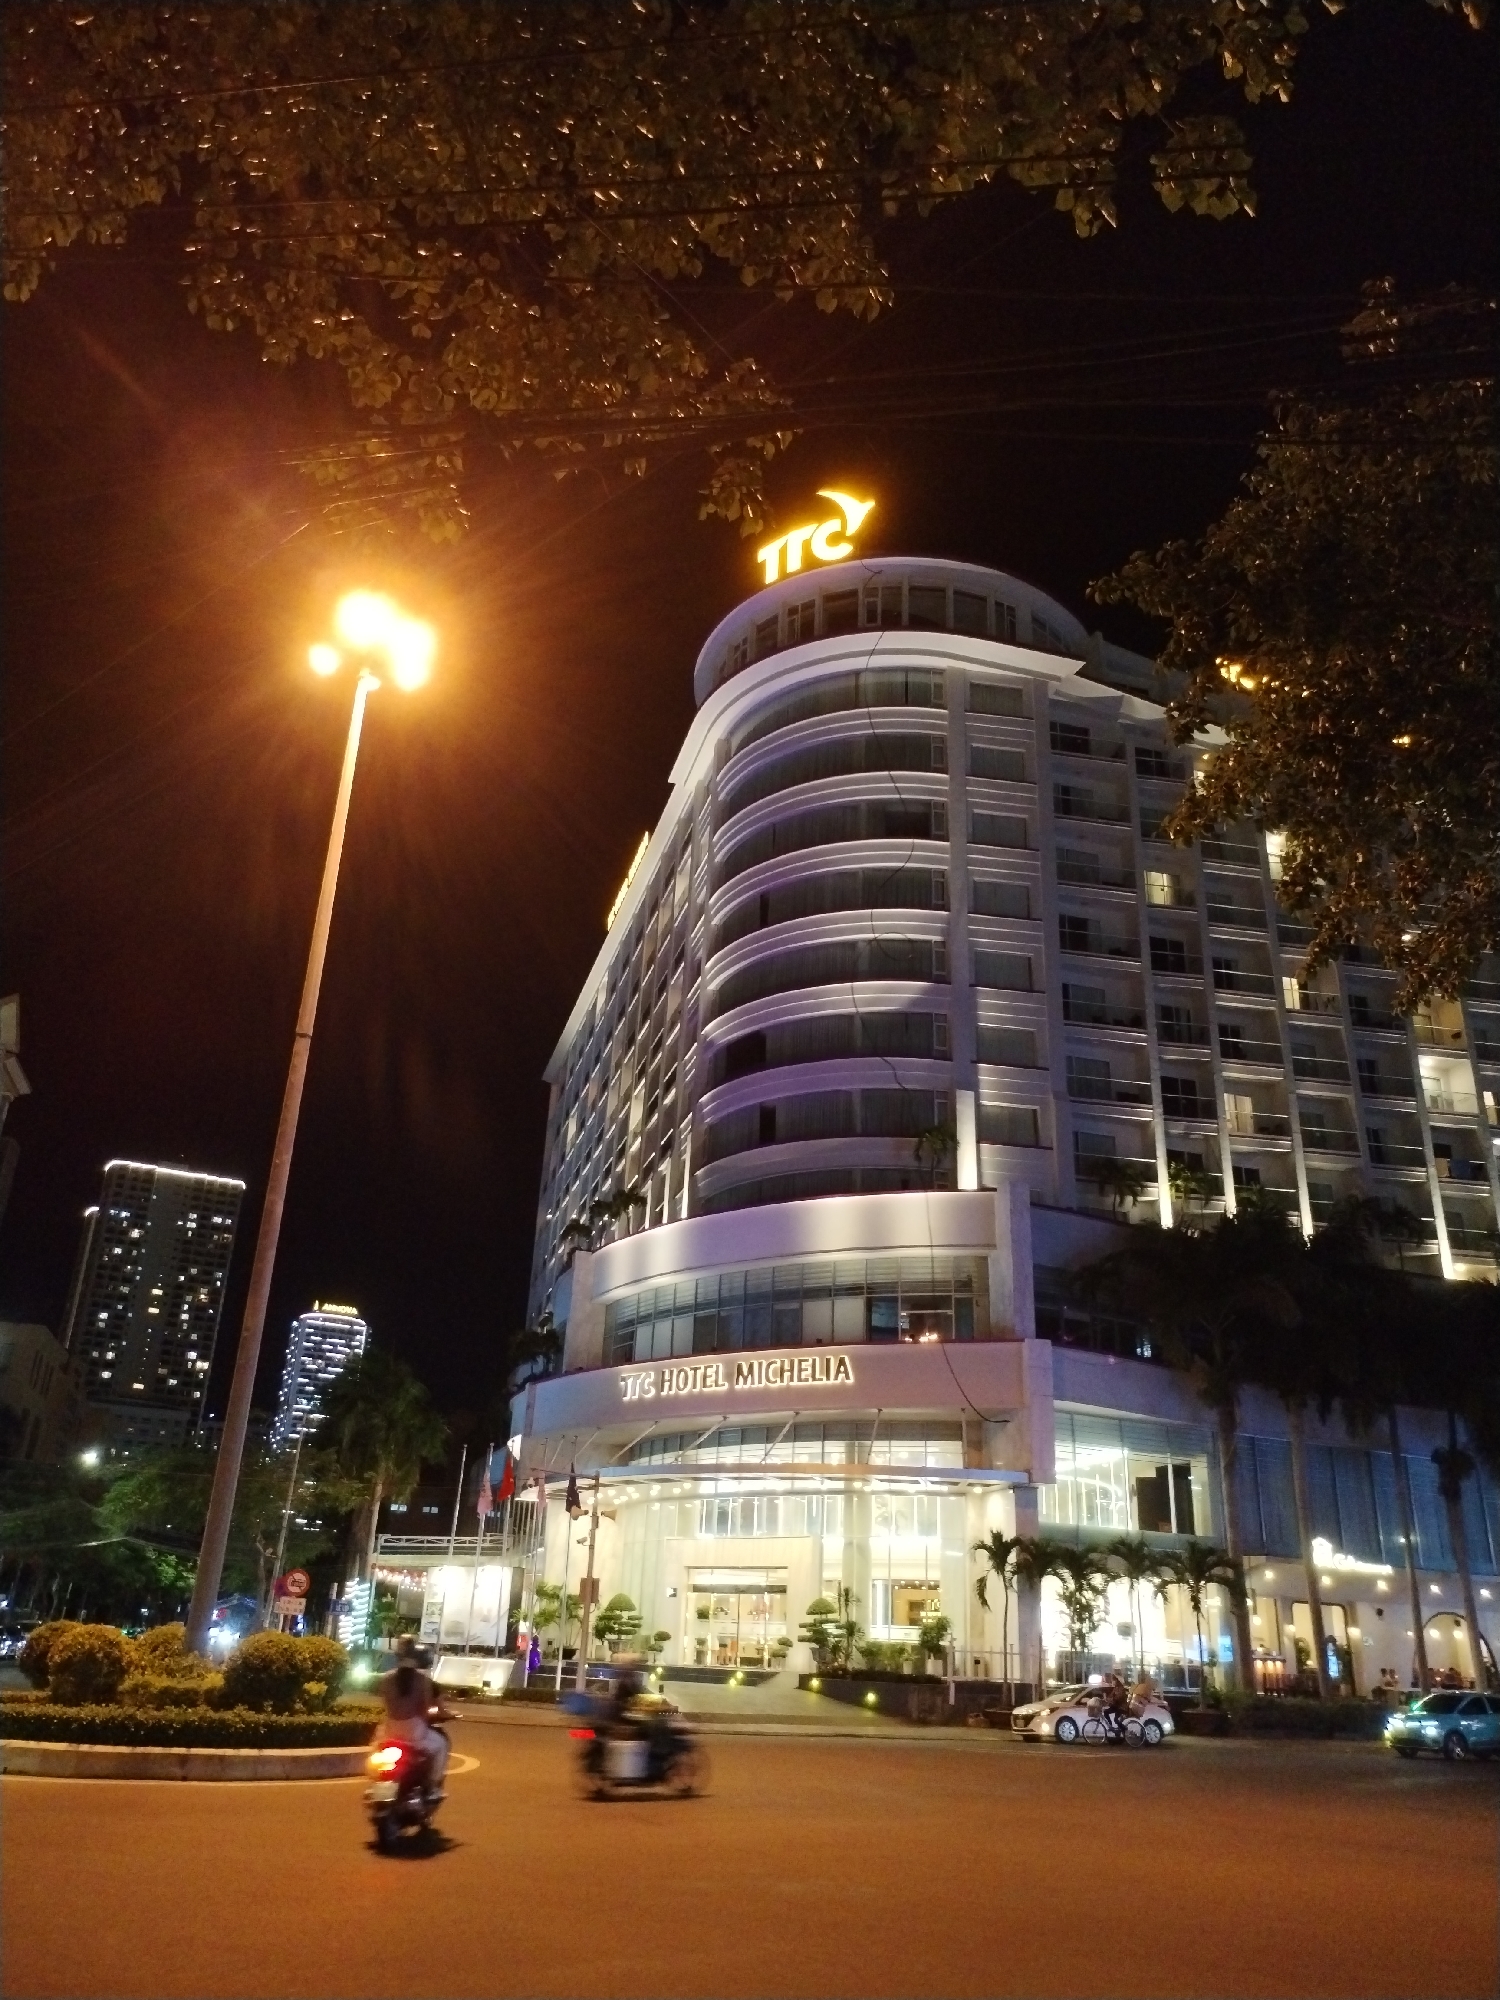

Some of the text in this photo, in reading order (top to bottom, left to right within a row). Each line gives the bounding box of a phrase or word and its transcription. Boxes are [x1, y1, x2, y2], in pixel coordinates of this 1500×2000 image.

[757, 518, 854, 585] TTC
[660, 1363, 728, 1396] HOTEL
[735, 1354, 854, 1389] MICHELIA
